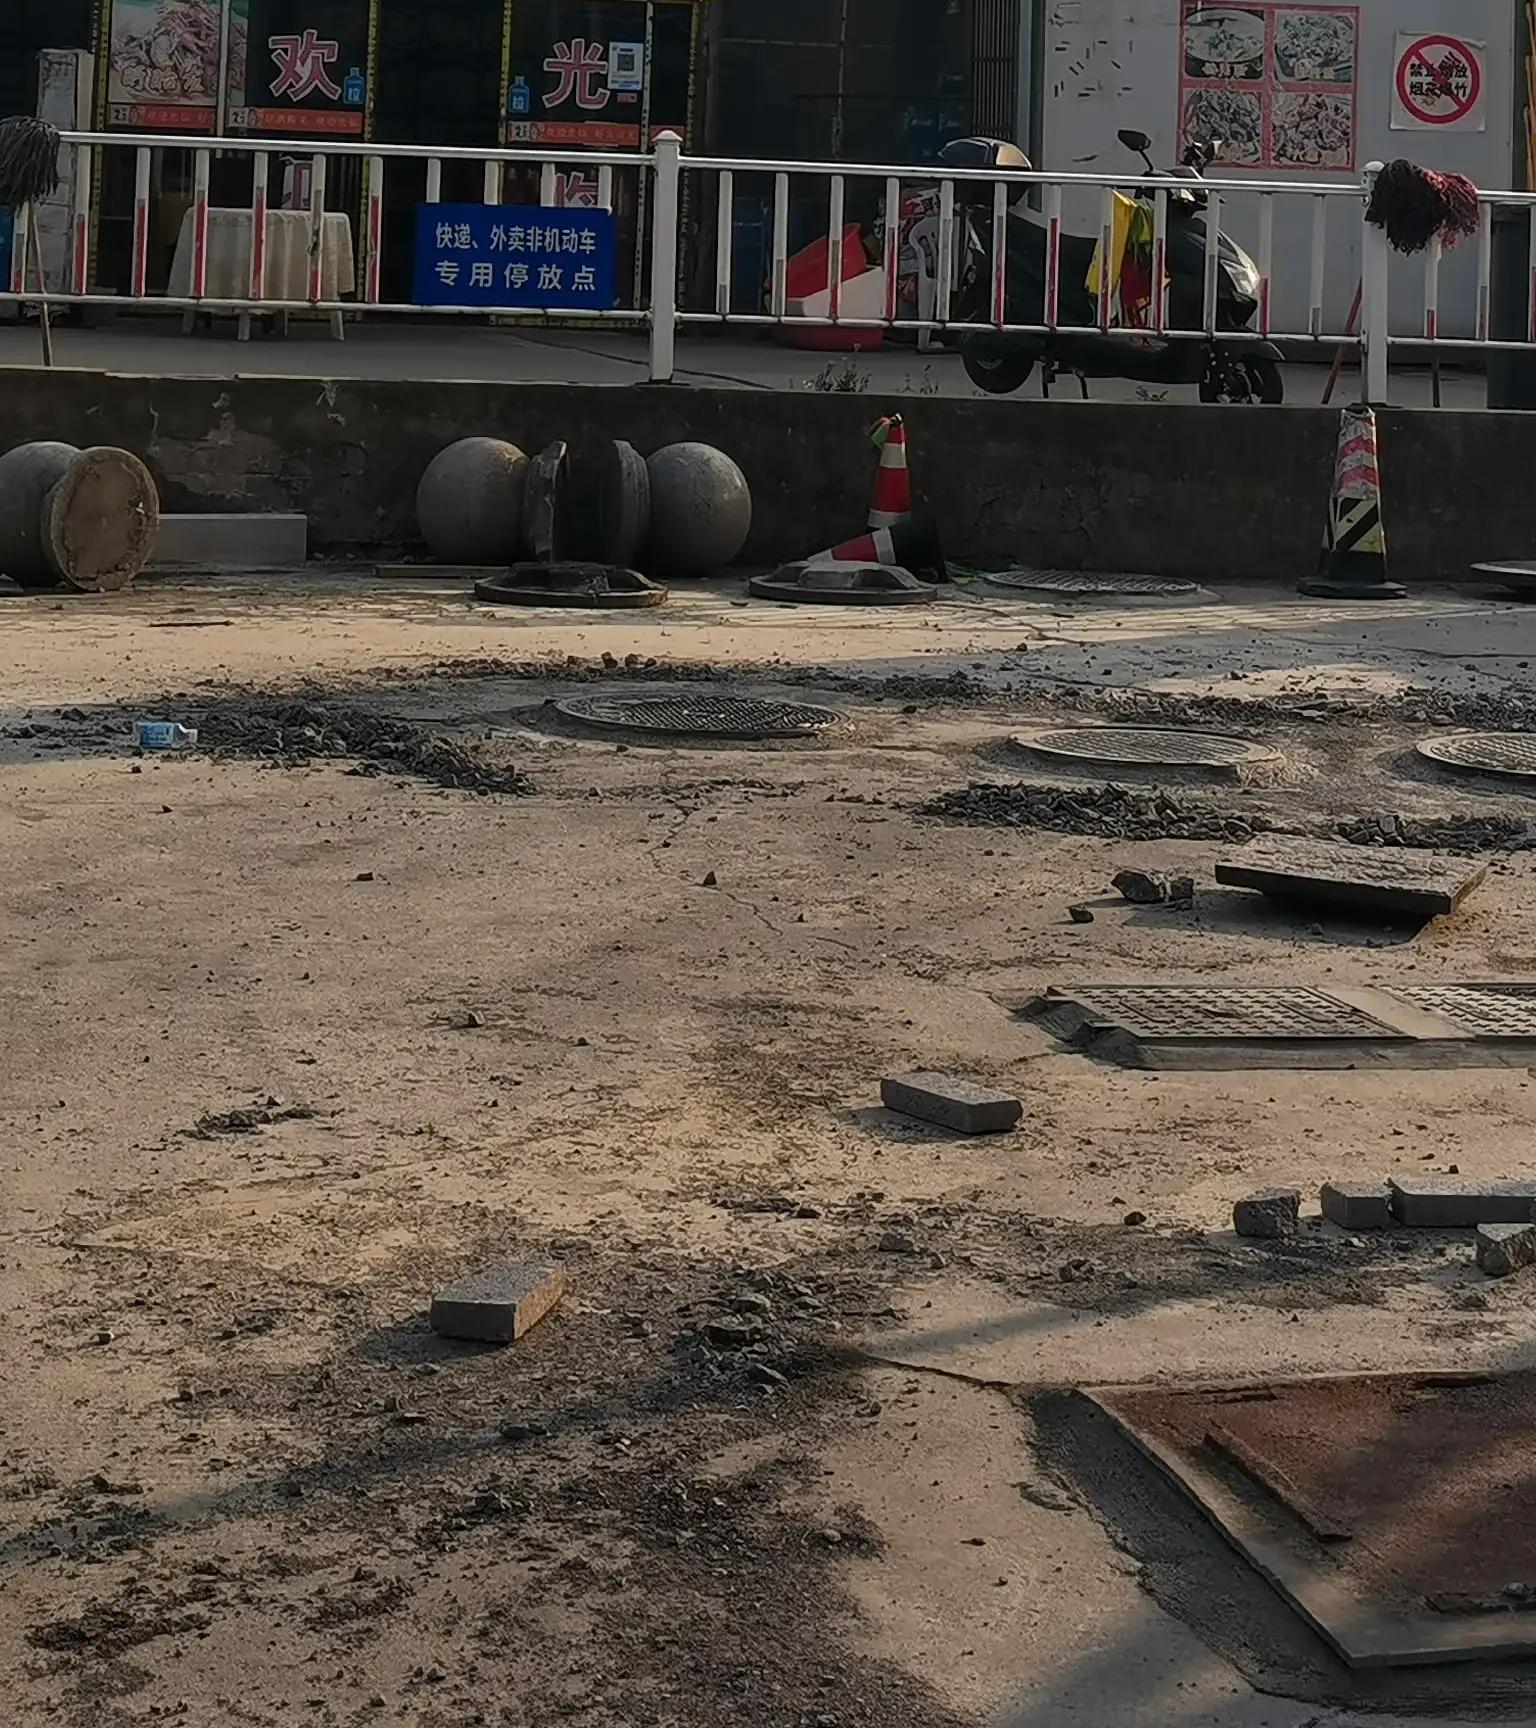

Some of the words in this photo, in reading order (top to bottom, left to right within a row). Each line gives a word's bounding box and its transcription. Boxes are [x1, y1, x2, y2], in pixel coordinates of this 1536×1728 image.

[435, 222, 596, 255] 快递、外卖非机动车
[434, 260, 596, 291] 专用停放点
